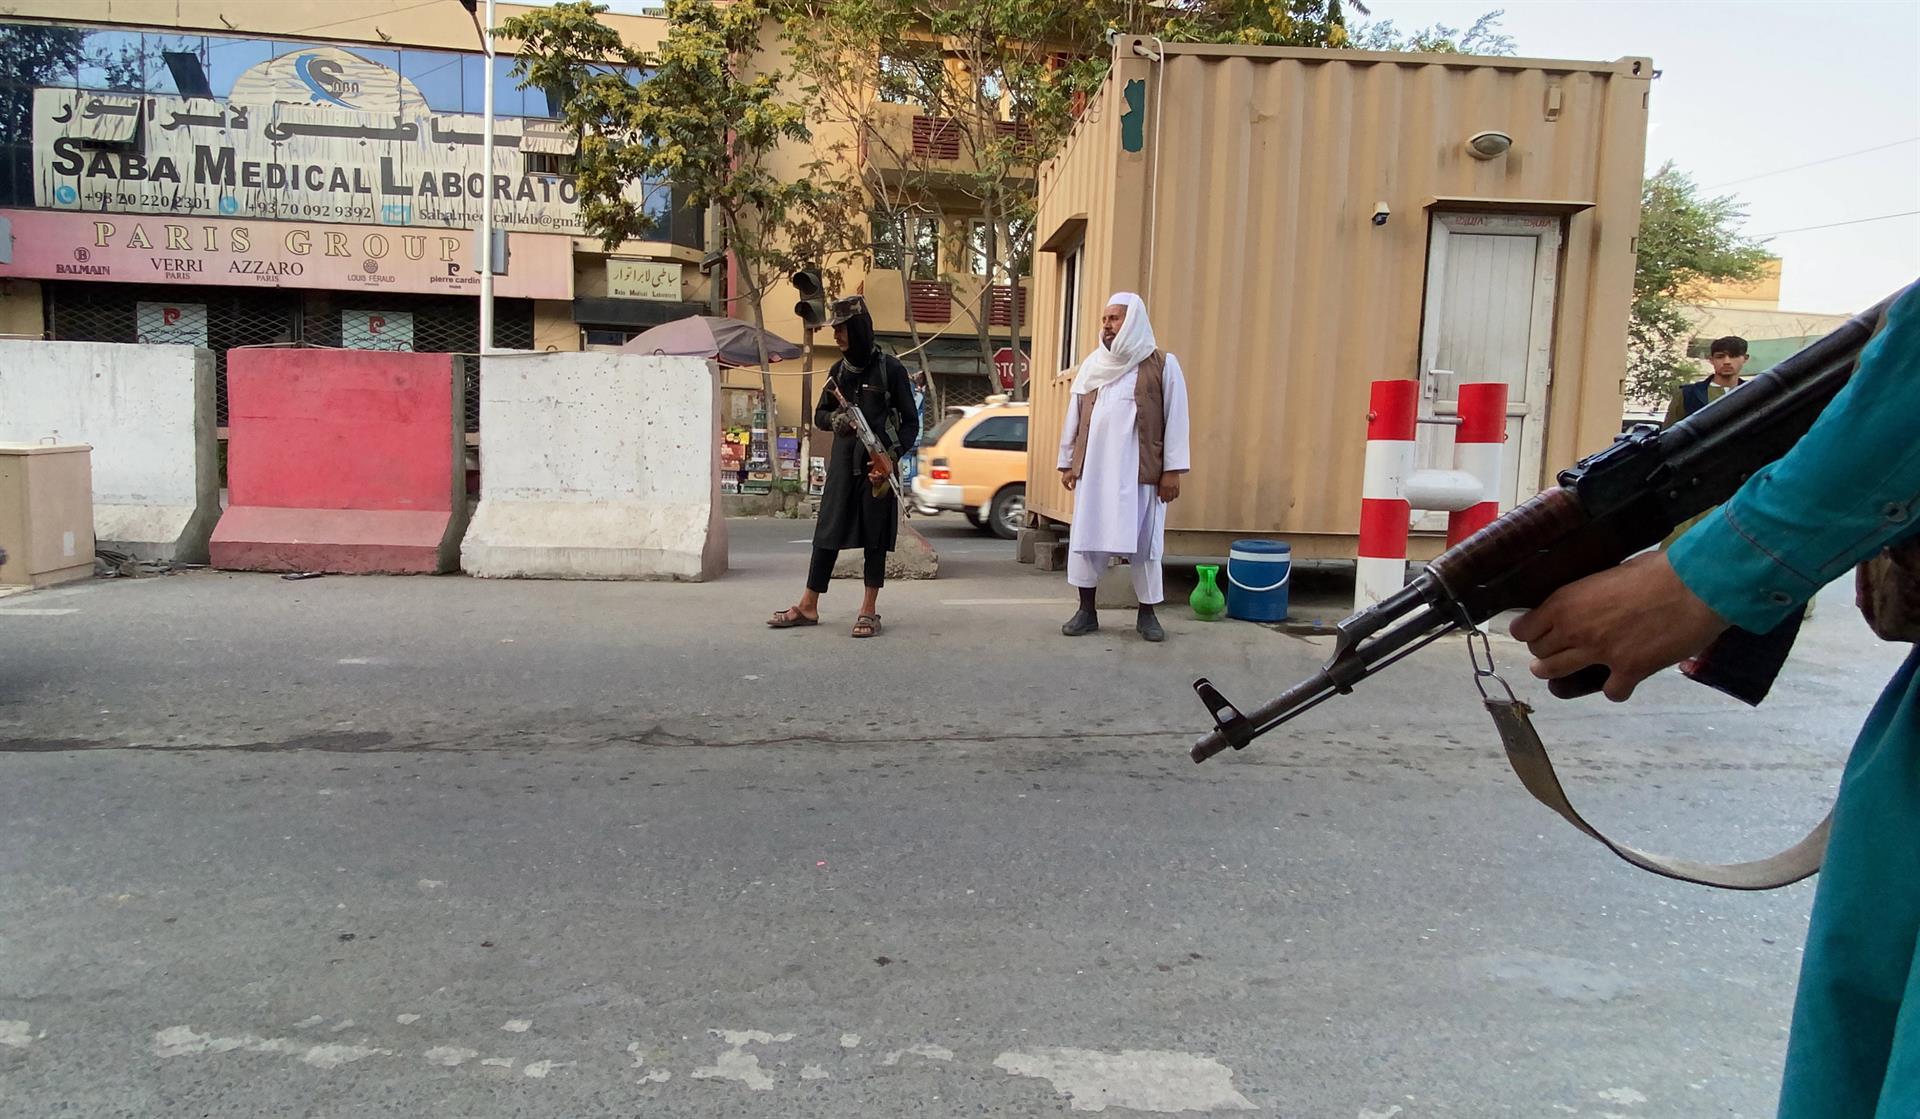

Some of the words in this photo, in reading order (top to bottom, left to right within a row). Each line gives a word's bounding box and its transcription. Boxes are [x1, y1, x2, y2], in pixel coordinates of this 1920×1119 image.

[52, 137, 180, 183] SABA
[194, 145, 372, 194] MEDICAL
[380, 156, 579, 203] LABORATO
[141, 194, 169, 208] 220
[249, 202, 275, 214] +93
[281, 203, 299, 215] 70
[303, 204, 330, 217] 092
[335, 205, 371, 219] 9392
[93, 221, 251, 253] PARIS
[285, 230, 461, 262] GROUP
[56, 264, 110, 275] BALMAIN
[151, 258, 203, 272] VERRI
[228, 261, 304, 276] AZZARO
[165, 272, 191, 280] PARIS
[256, 275, 280, 283] PARIS
[347, 274, 367, 282] LOUIS
[430, 275, 454, 284] pierre
[455, 277, 481, 285] cardin
